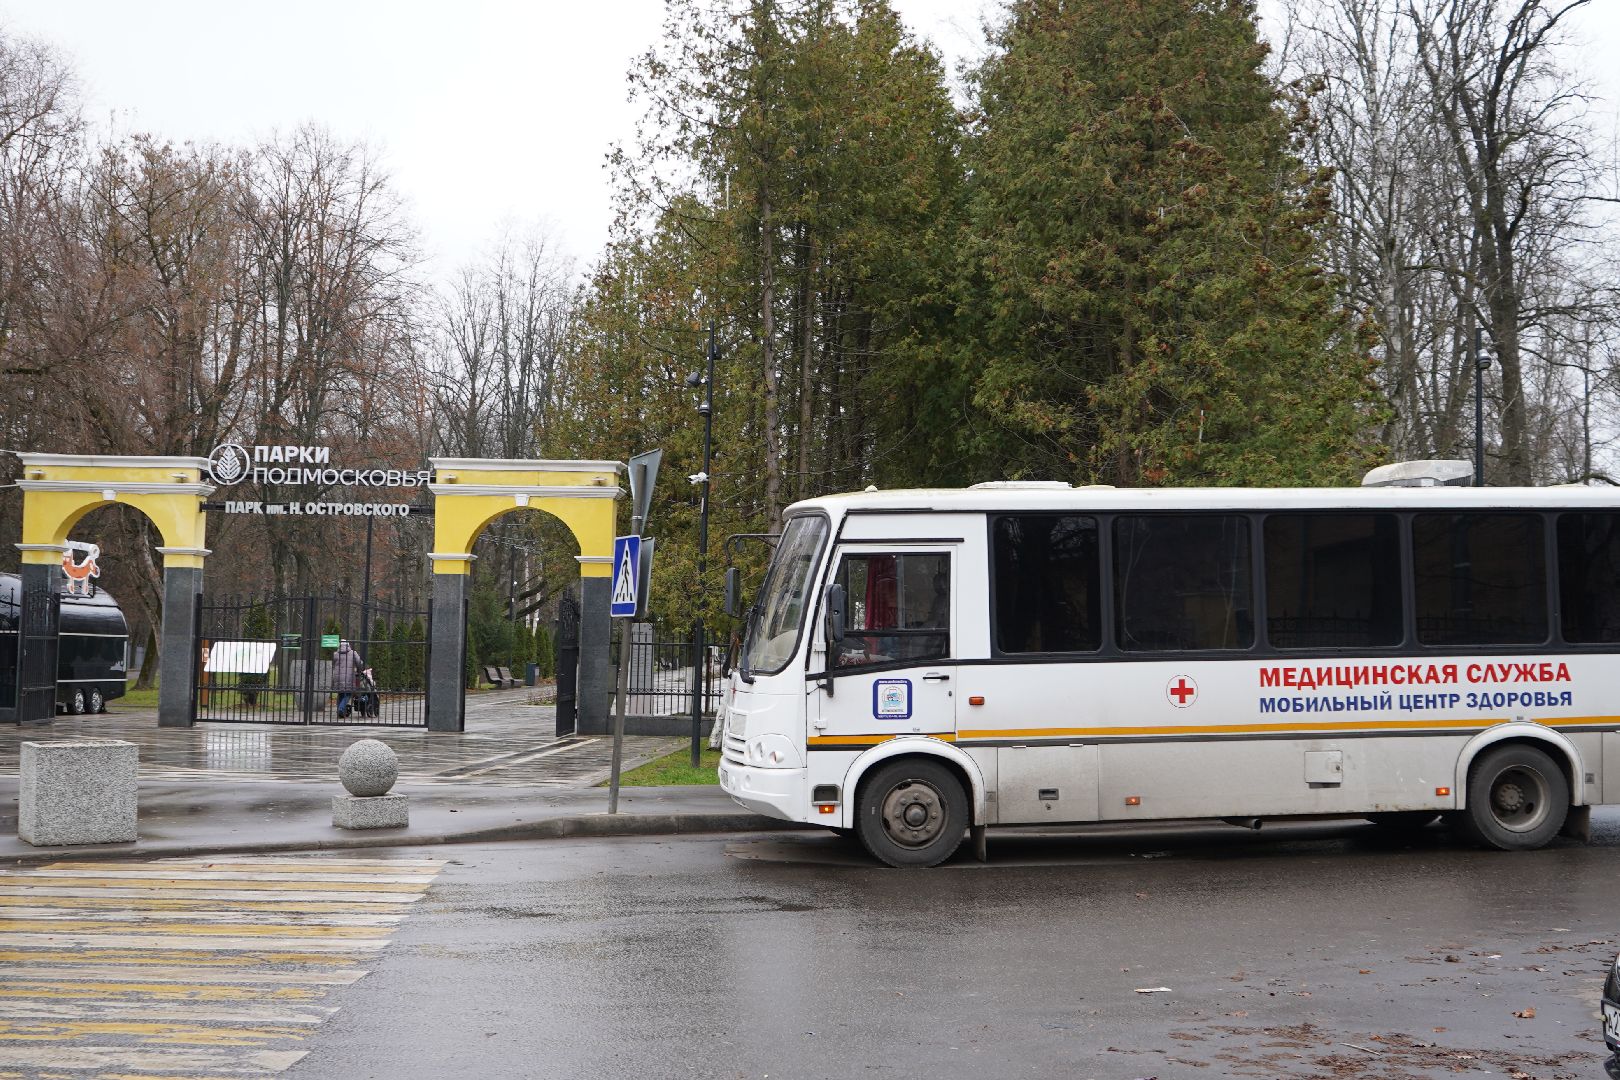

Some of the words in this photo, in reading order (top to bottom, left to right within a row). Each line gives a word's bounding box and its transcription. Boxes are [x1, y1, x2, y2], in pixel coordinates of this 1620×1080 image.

[254, 446, 330, 464] ПАРКИ
[253, 467, 431, 486] ПОДМОСКОВЬЯ
[225, 501, 263, 514] ПАРК
[266, 504, 287, 515] им.
[289, 503, 303, 515] Н.
[305, 502, 410, 516] ОСТРОВСКОГО
[1259, 664, 1458, 690] МЕДИЦИНСКАЯ
[1466, 662, 1572, 685] СЛУЖБА
[1259, 690, 1391, 713] МОБИЛЬНЫЙ
[1399, 692, 1460, 712] ЦЕНТР
[1466, 691, 1572, 710] ЗДОРОВЬЯ
